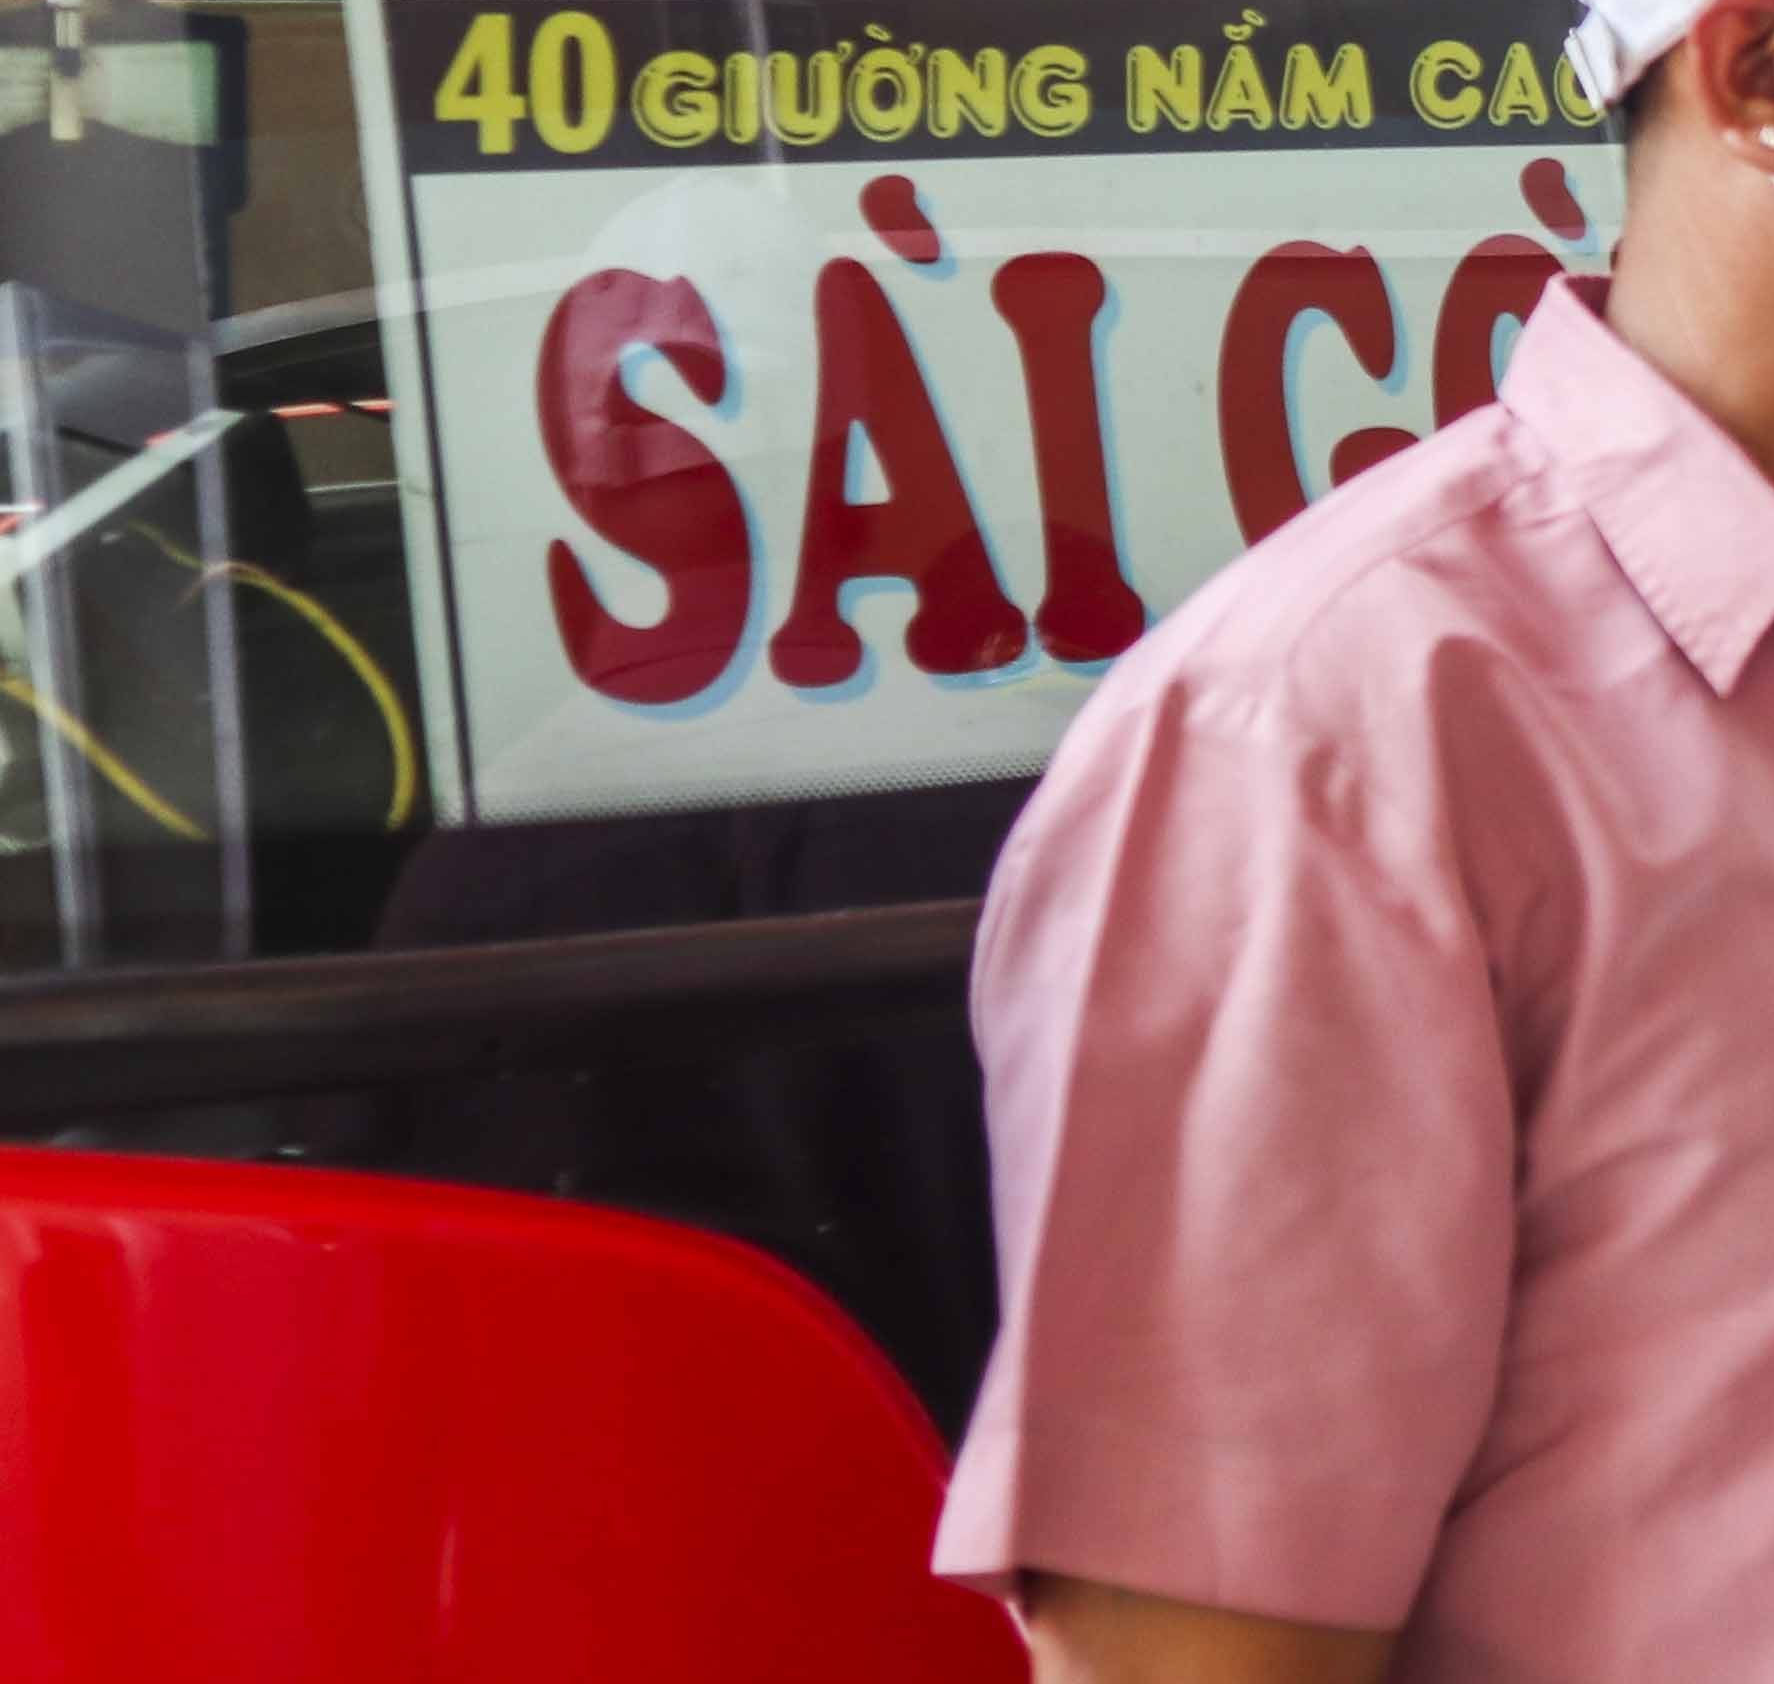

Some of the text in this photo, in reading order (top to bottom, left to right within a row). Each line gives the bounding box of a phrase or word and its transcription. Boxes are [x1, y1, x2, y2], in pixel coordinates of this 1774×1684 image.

[433, 9, 618, 155] 40
[630, 21, 1091, 149] GIƯỜNG
[1125, 8, 1375, 134] NẰM
[535, 174, 1156, 709] SÀI
